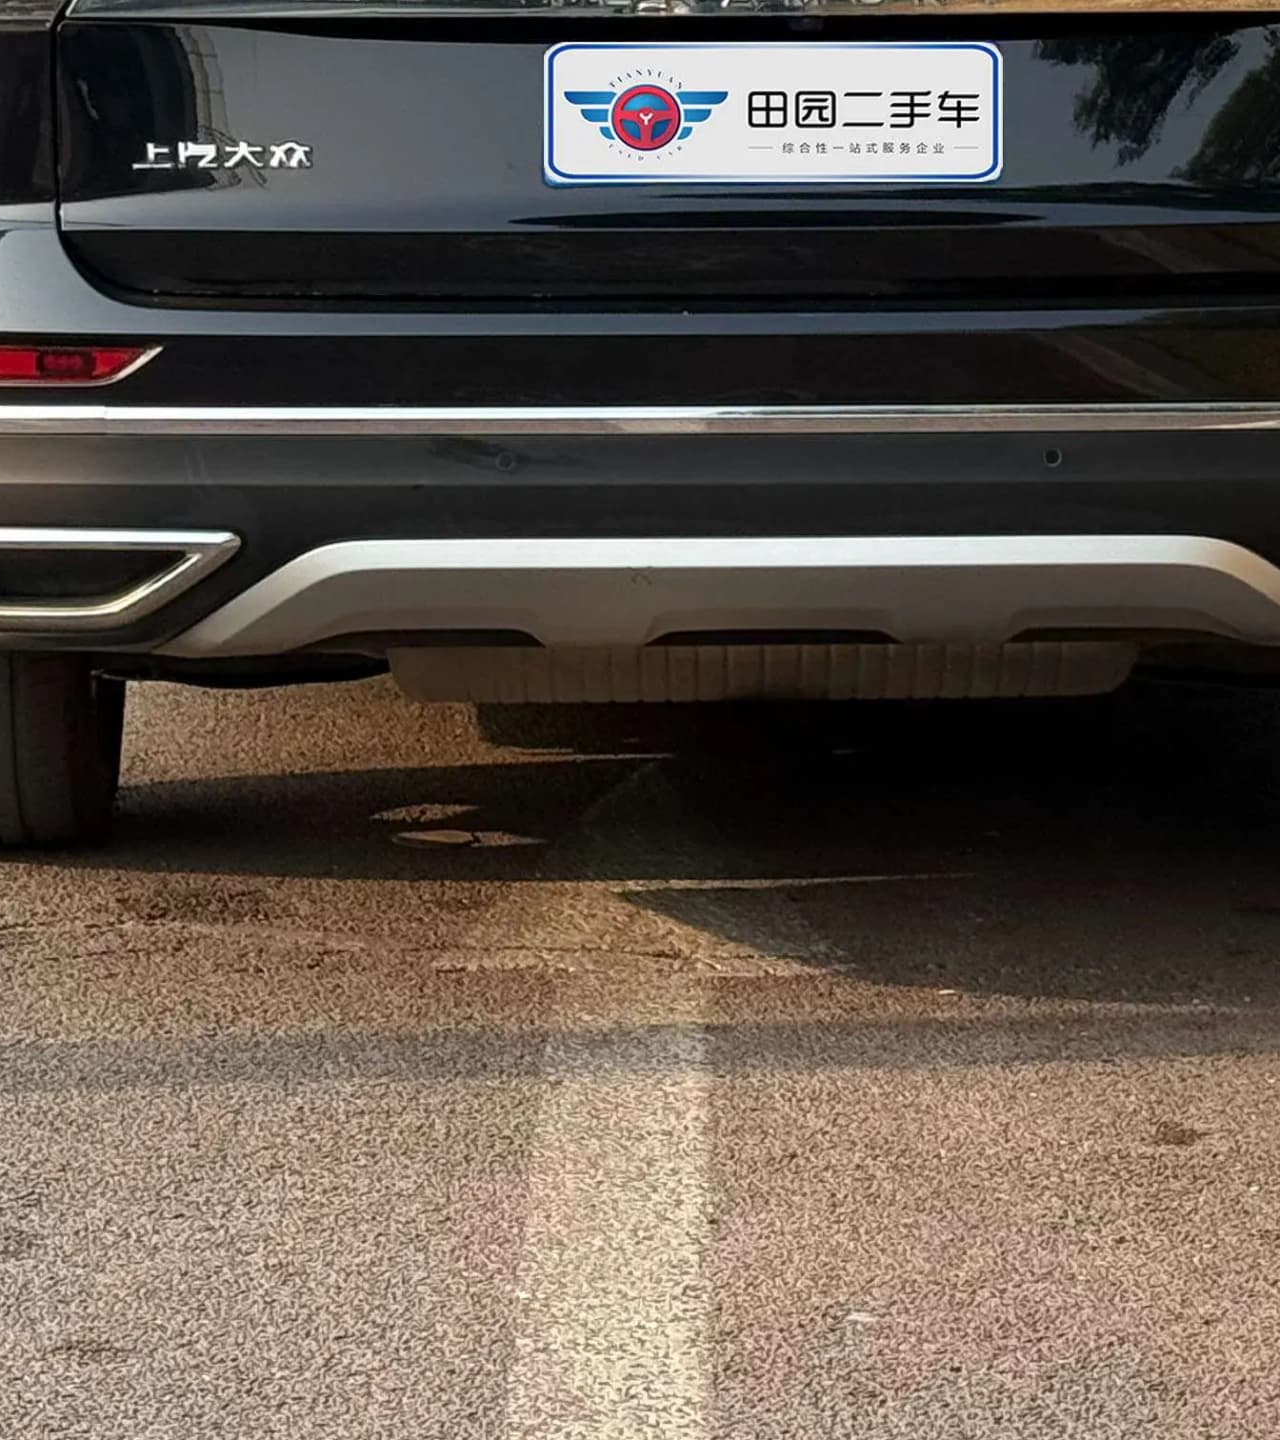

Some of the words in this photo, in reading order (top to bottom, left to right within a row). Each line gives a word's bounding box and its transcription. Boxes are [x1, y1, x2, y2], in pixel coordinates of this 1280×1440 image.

[747, 90, 980, 128] 田园二手车
[131, 140, 312, 170] 上汽大众
[781, 142, 946, 155] 综合性一站式服务企业
